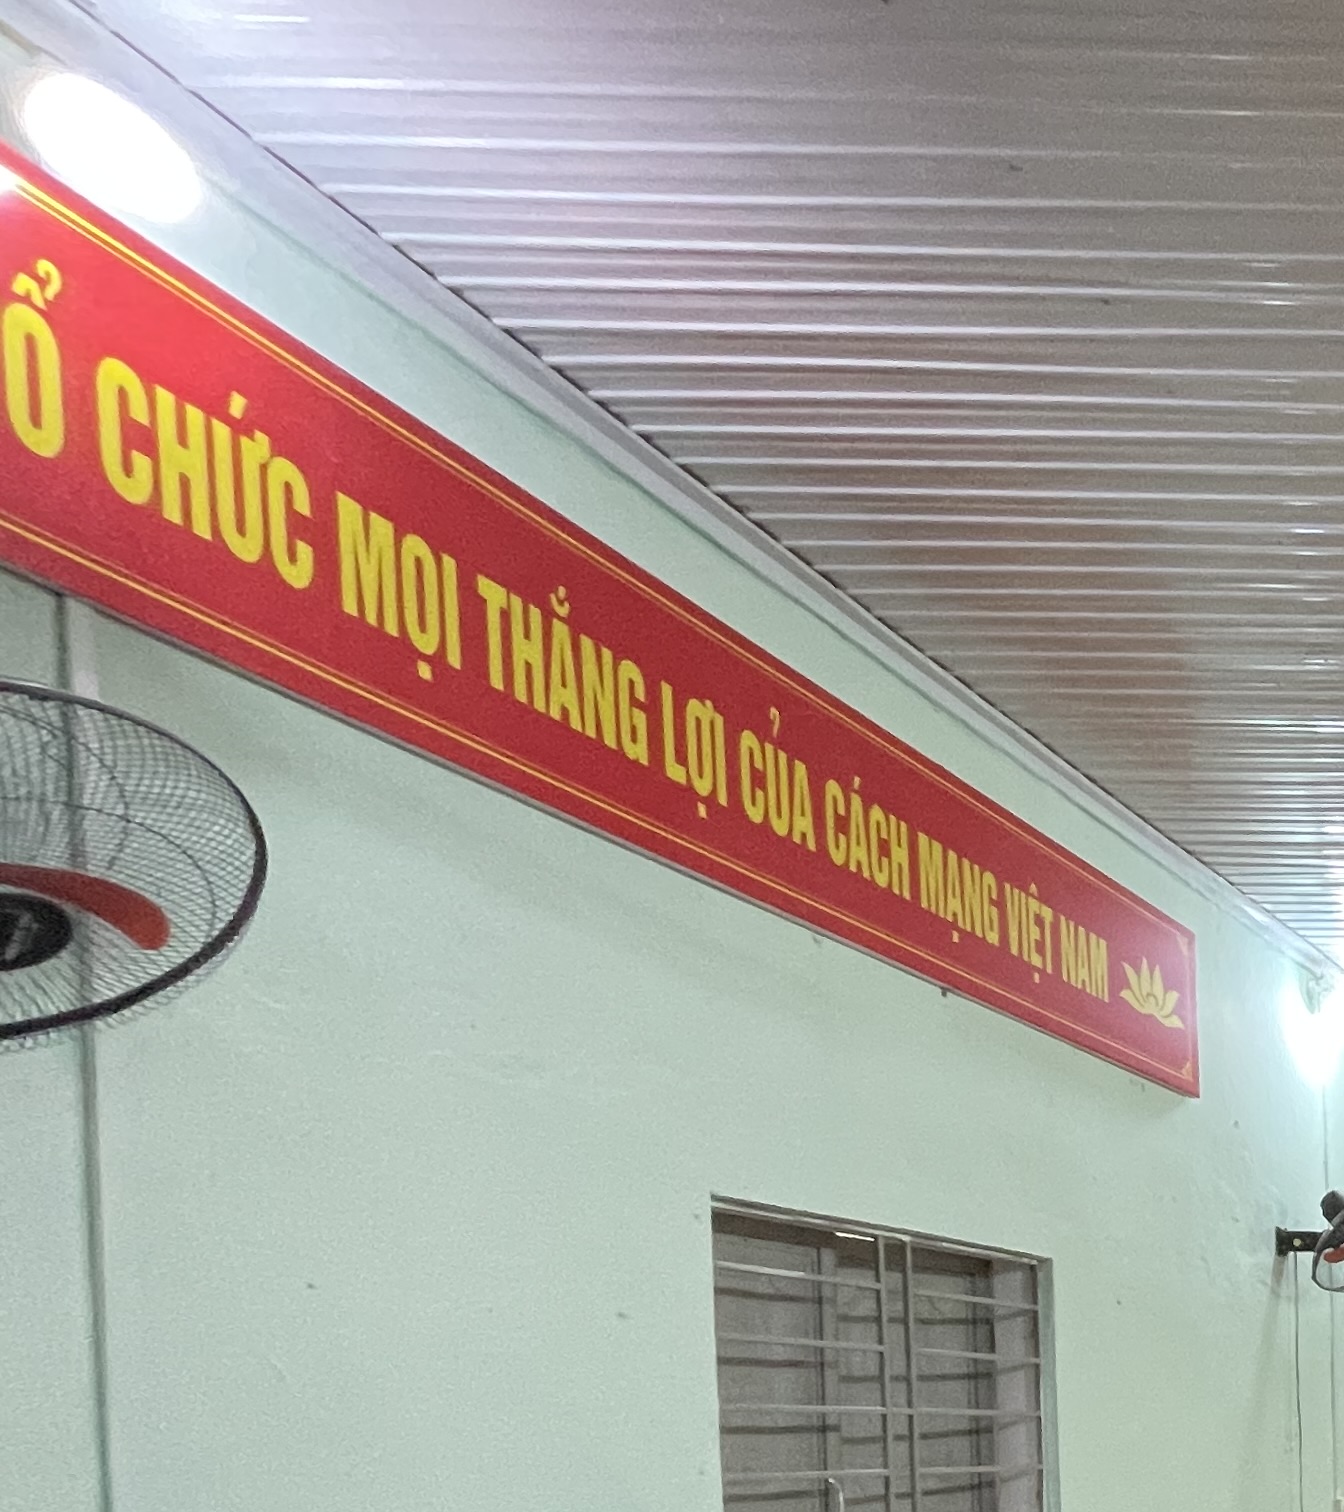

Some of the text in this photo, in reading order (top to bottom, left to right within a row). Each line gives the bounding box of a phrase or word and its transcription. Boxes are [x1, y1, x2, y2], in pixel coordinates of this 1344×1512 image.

[96, 357, 314, 588] CHỨC
[336, 491, 462, 681] MỌI
[476, 573, 649, 766] THẮNG
[661, 681, 727, 819] LỢI
[740, 707, 816, 851] CỦA
[824, 777, 911, 900] CÁCH
[919, 832, 999, 943] MẠNG
[1004, 883, 1054, 983] VIỆT
[1060, 914, 1109, 1003] NAM
